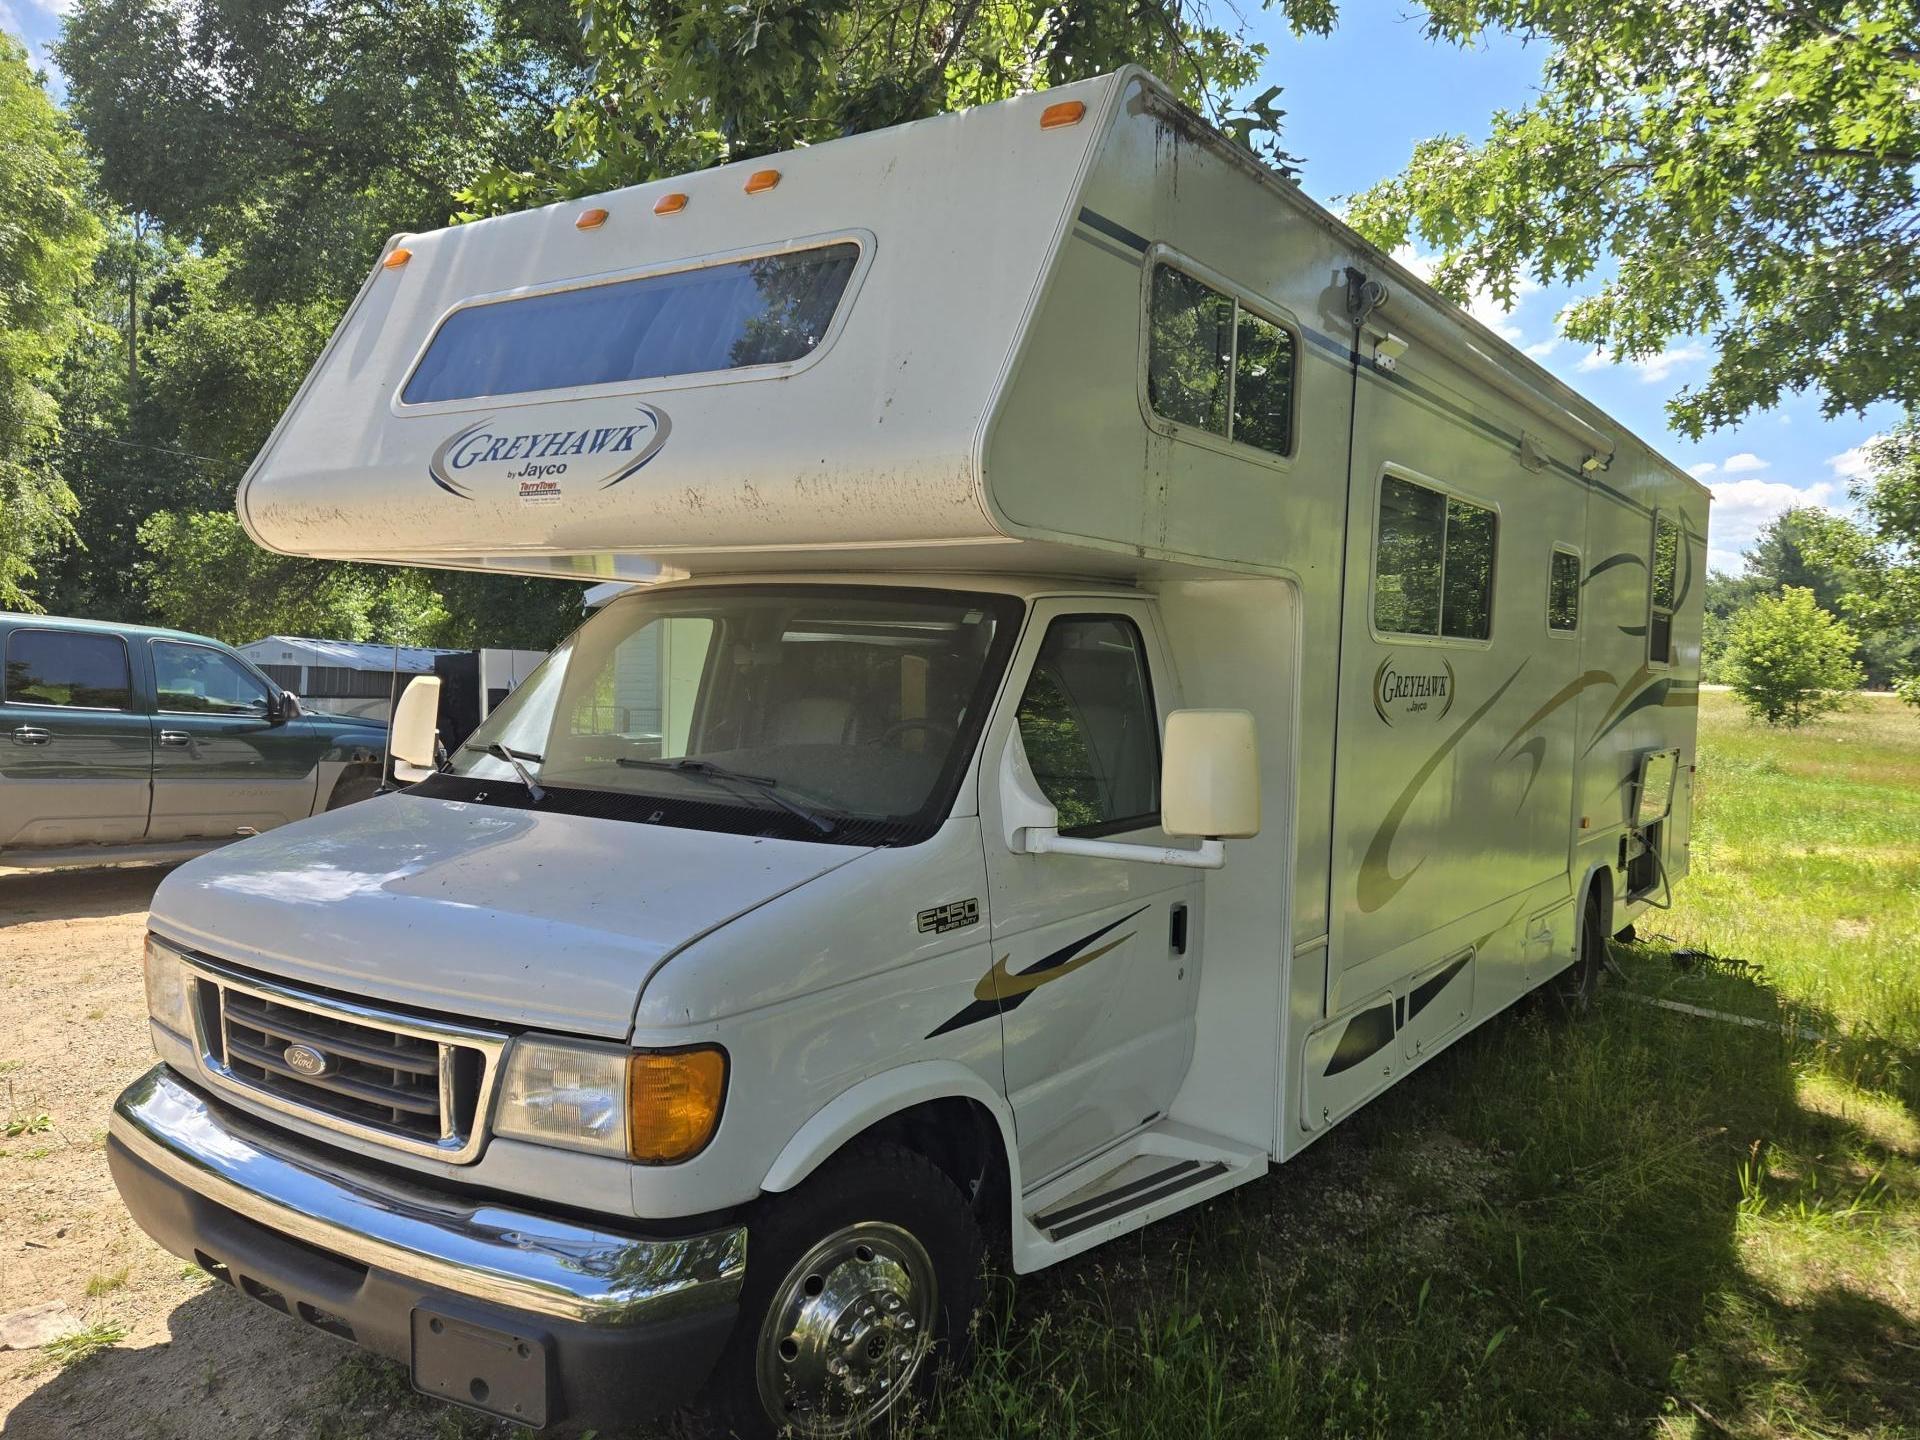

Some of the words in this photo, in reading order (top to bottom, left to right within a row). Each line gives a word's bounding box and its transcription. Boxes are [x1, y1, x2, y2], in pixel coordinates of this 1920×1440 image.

[452, 425, 648, 469] GREYHAWK
[507, 470, 516, 479] by
[518, 462, 567, 479] Jayco
[1383, 671, 1448, 703] GREYHAWK
[292, 1051, 314, 1069] Ford
